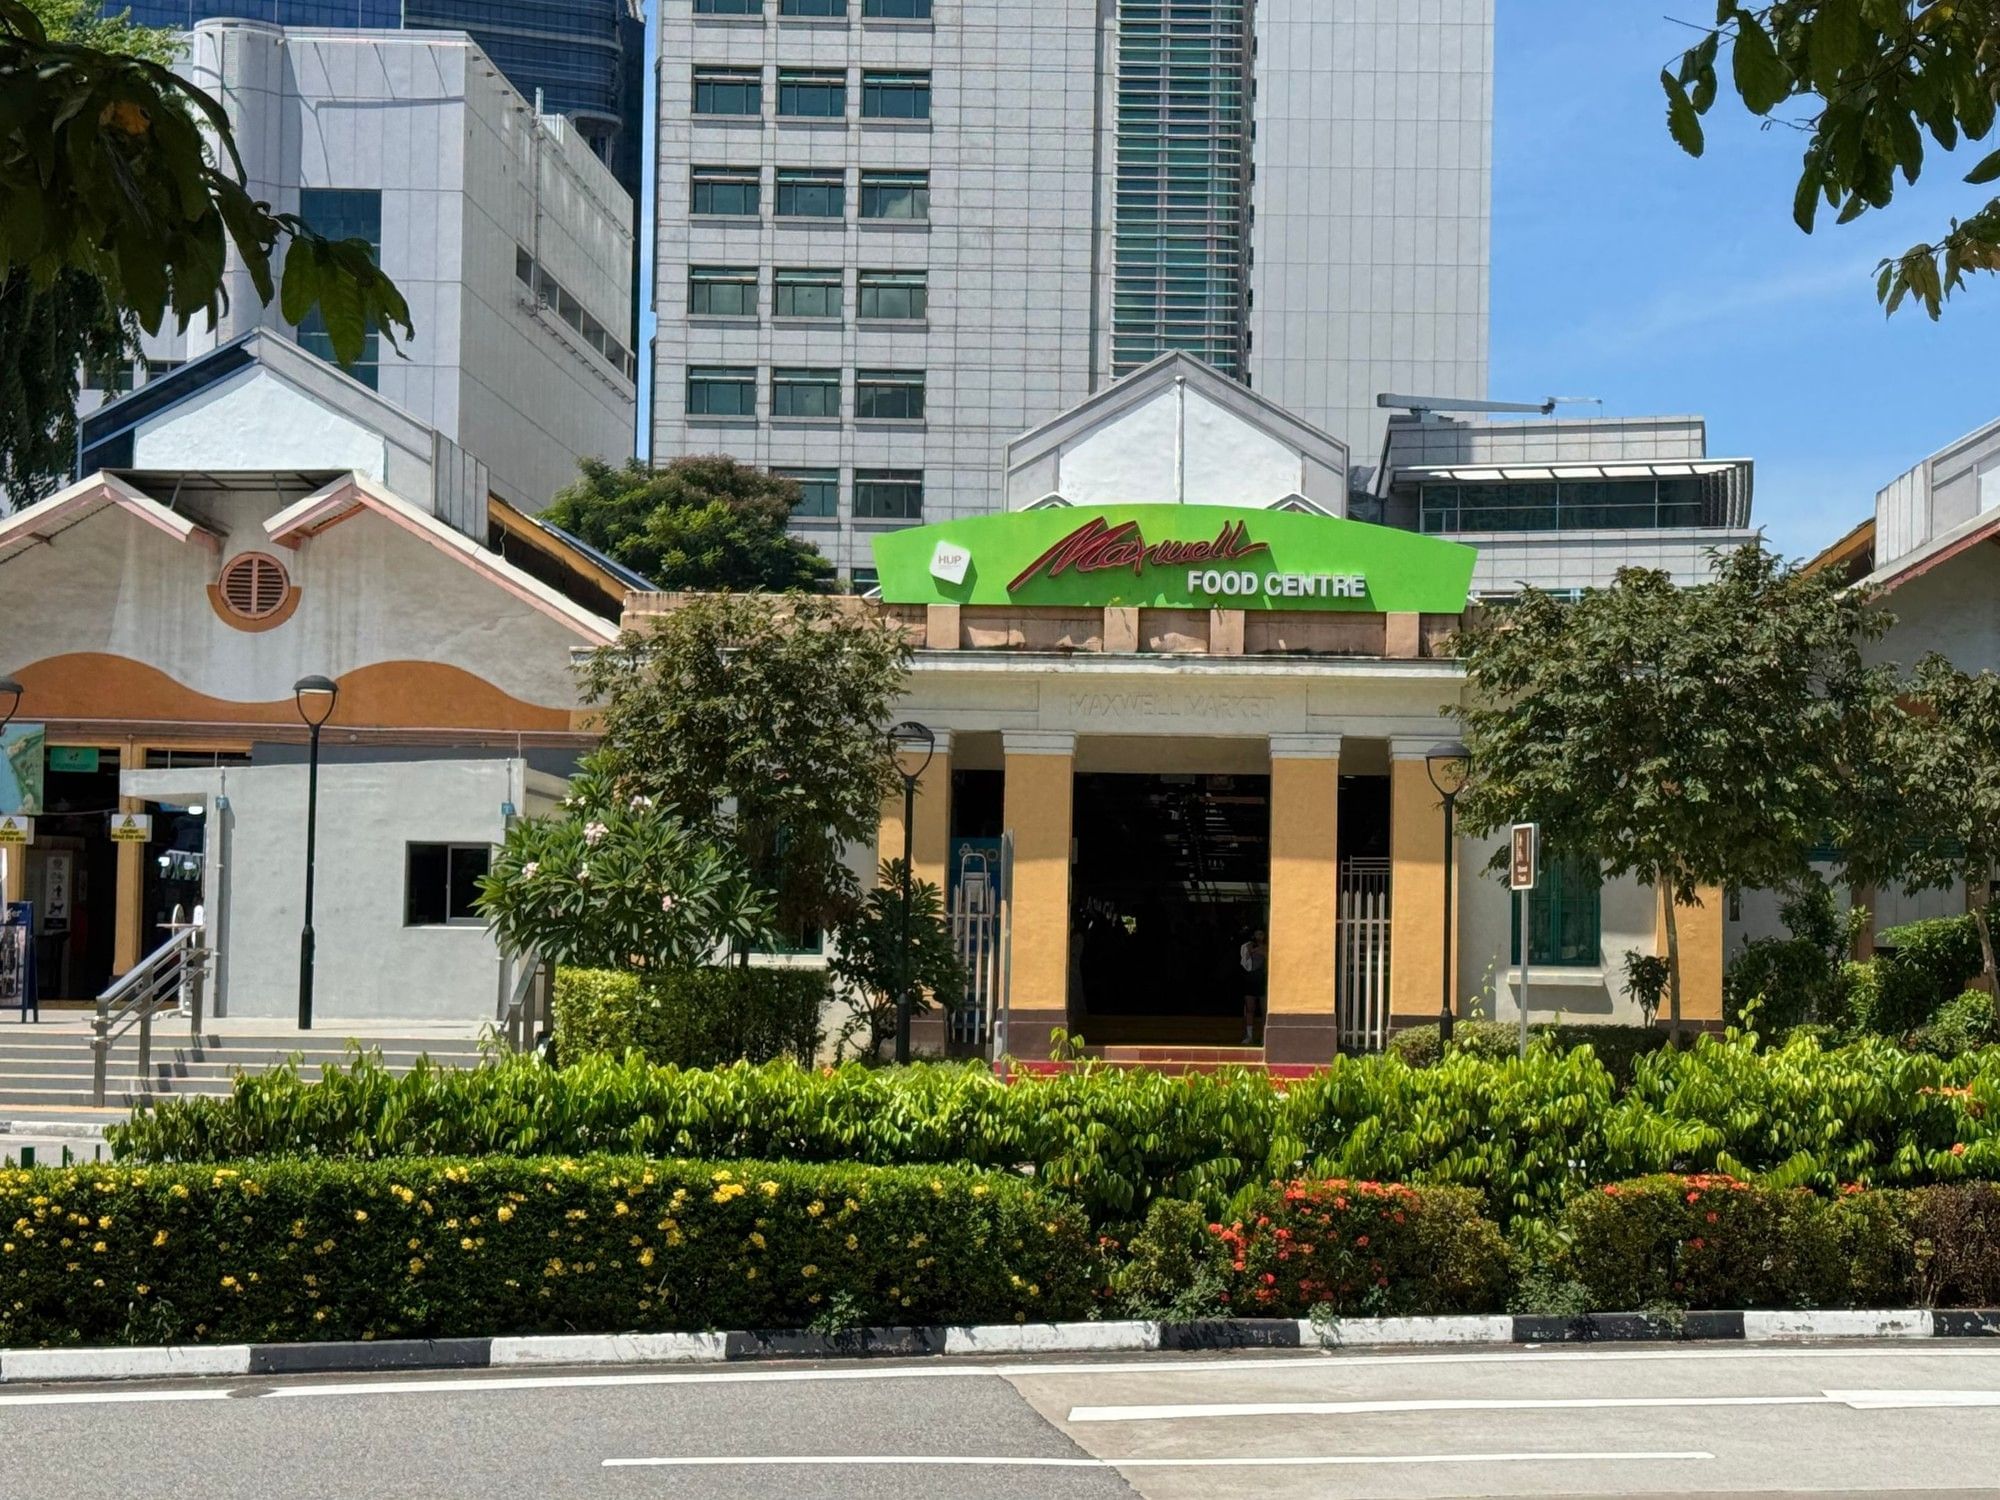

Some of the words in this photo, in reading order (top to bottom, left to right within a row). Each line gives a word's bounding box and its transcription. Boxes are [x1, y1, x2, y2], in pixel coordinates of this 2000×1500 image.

[938, 555, 962, 565] HUP
[1007, 516, 1270, 593] Maxwell
[1187, 570, 1258, 595] FOOD
[1264, 571, 1366, 598] CENTRE
[1068, 694, 1181, 717] MAXWELL
[1184, 694, 1275, 718] MARKET
